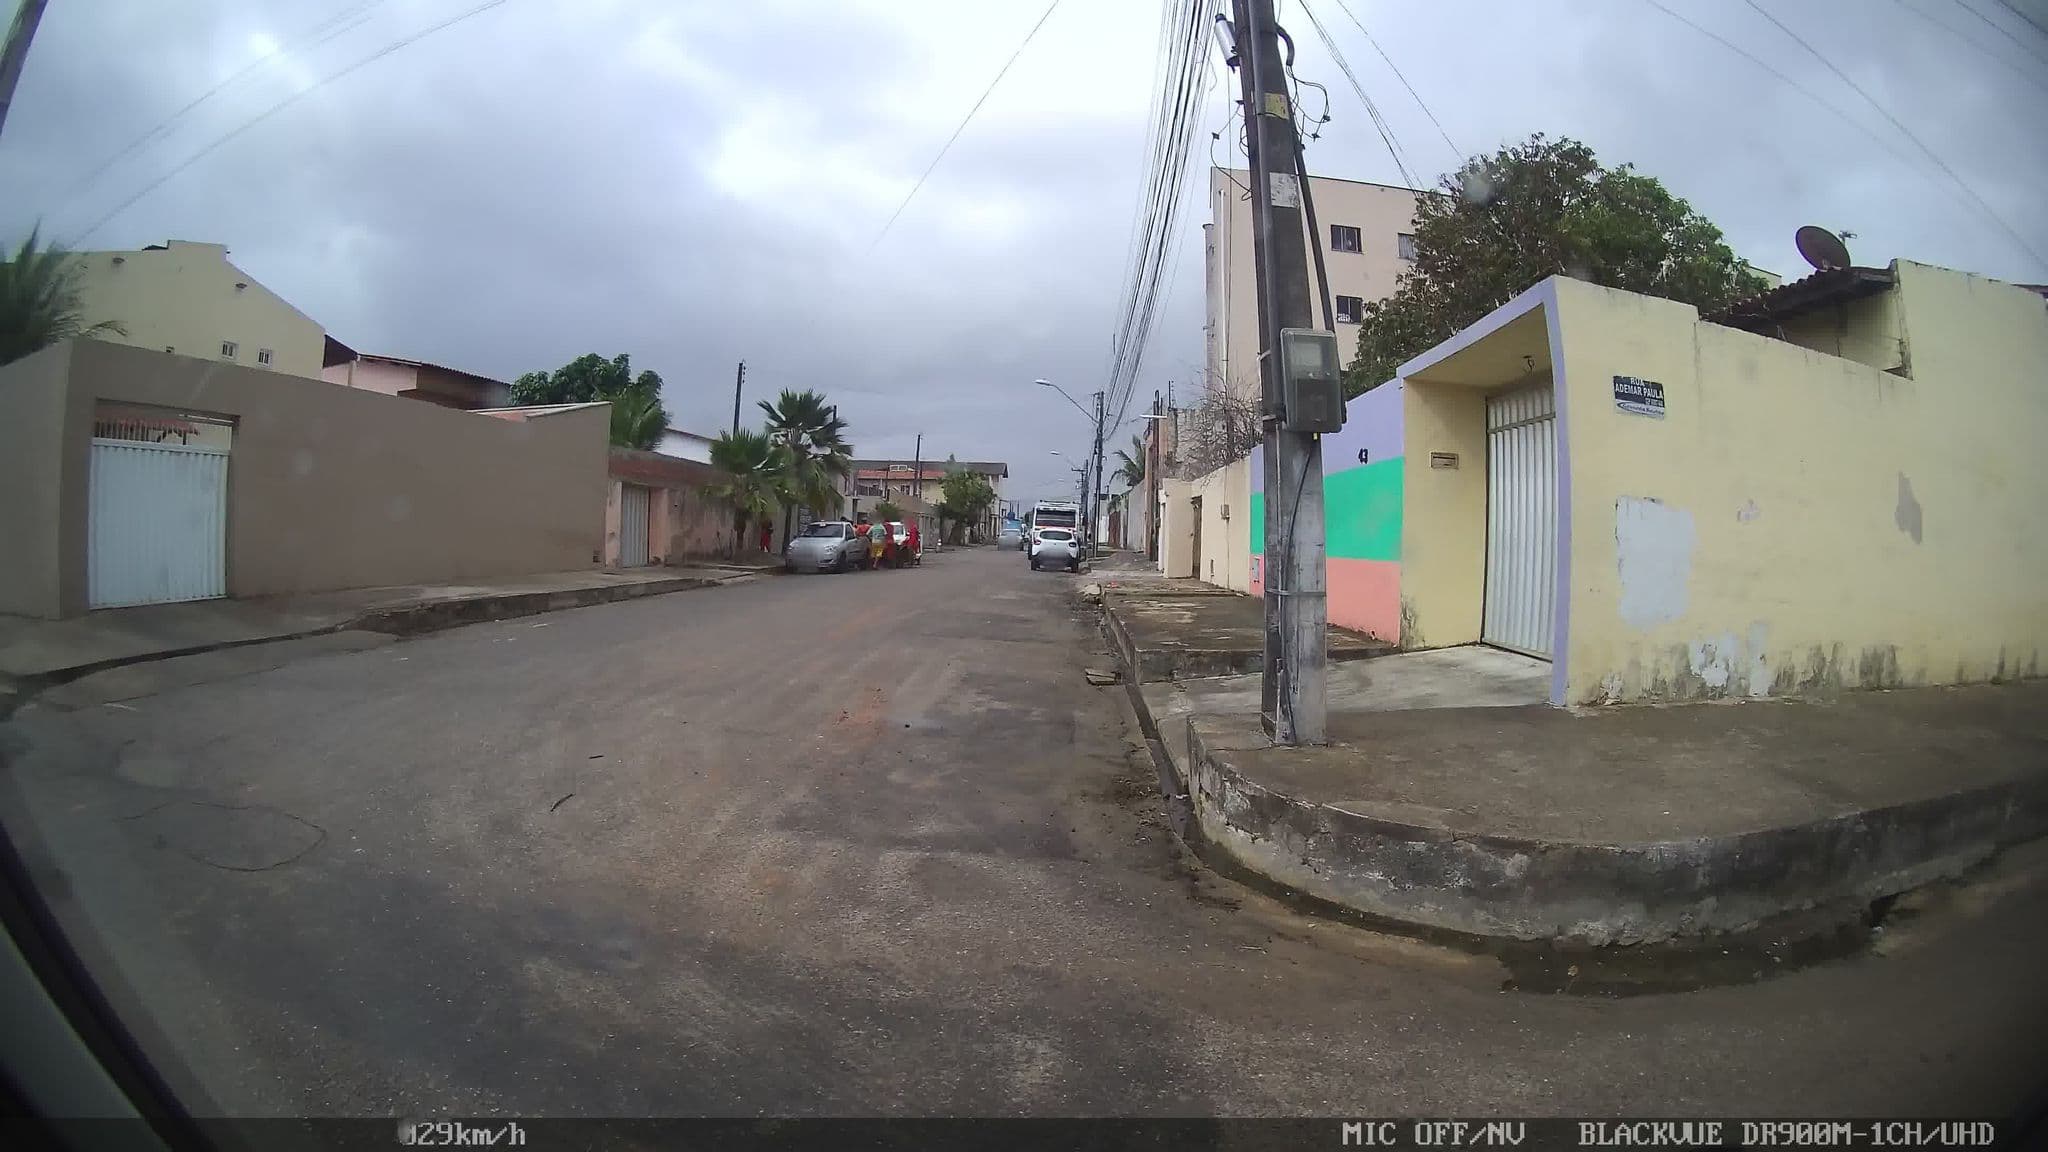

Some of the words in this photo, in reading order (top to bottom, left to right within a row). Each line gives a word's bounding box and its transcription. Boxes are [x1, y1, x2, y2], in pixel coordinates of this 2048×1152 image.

[1630, 377, 1645, 387] RUA
[1615, 383, 1643, 396] ADEMAR
[1643, 387, 1664, 399] PAULA
[1358, 448, 1369, 464] 43
